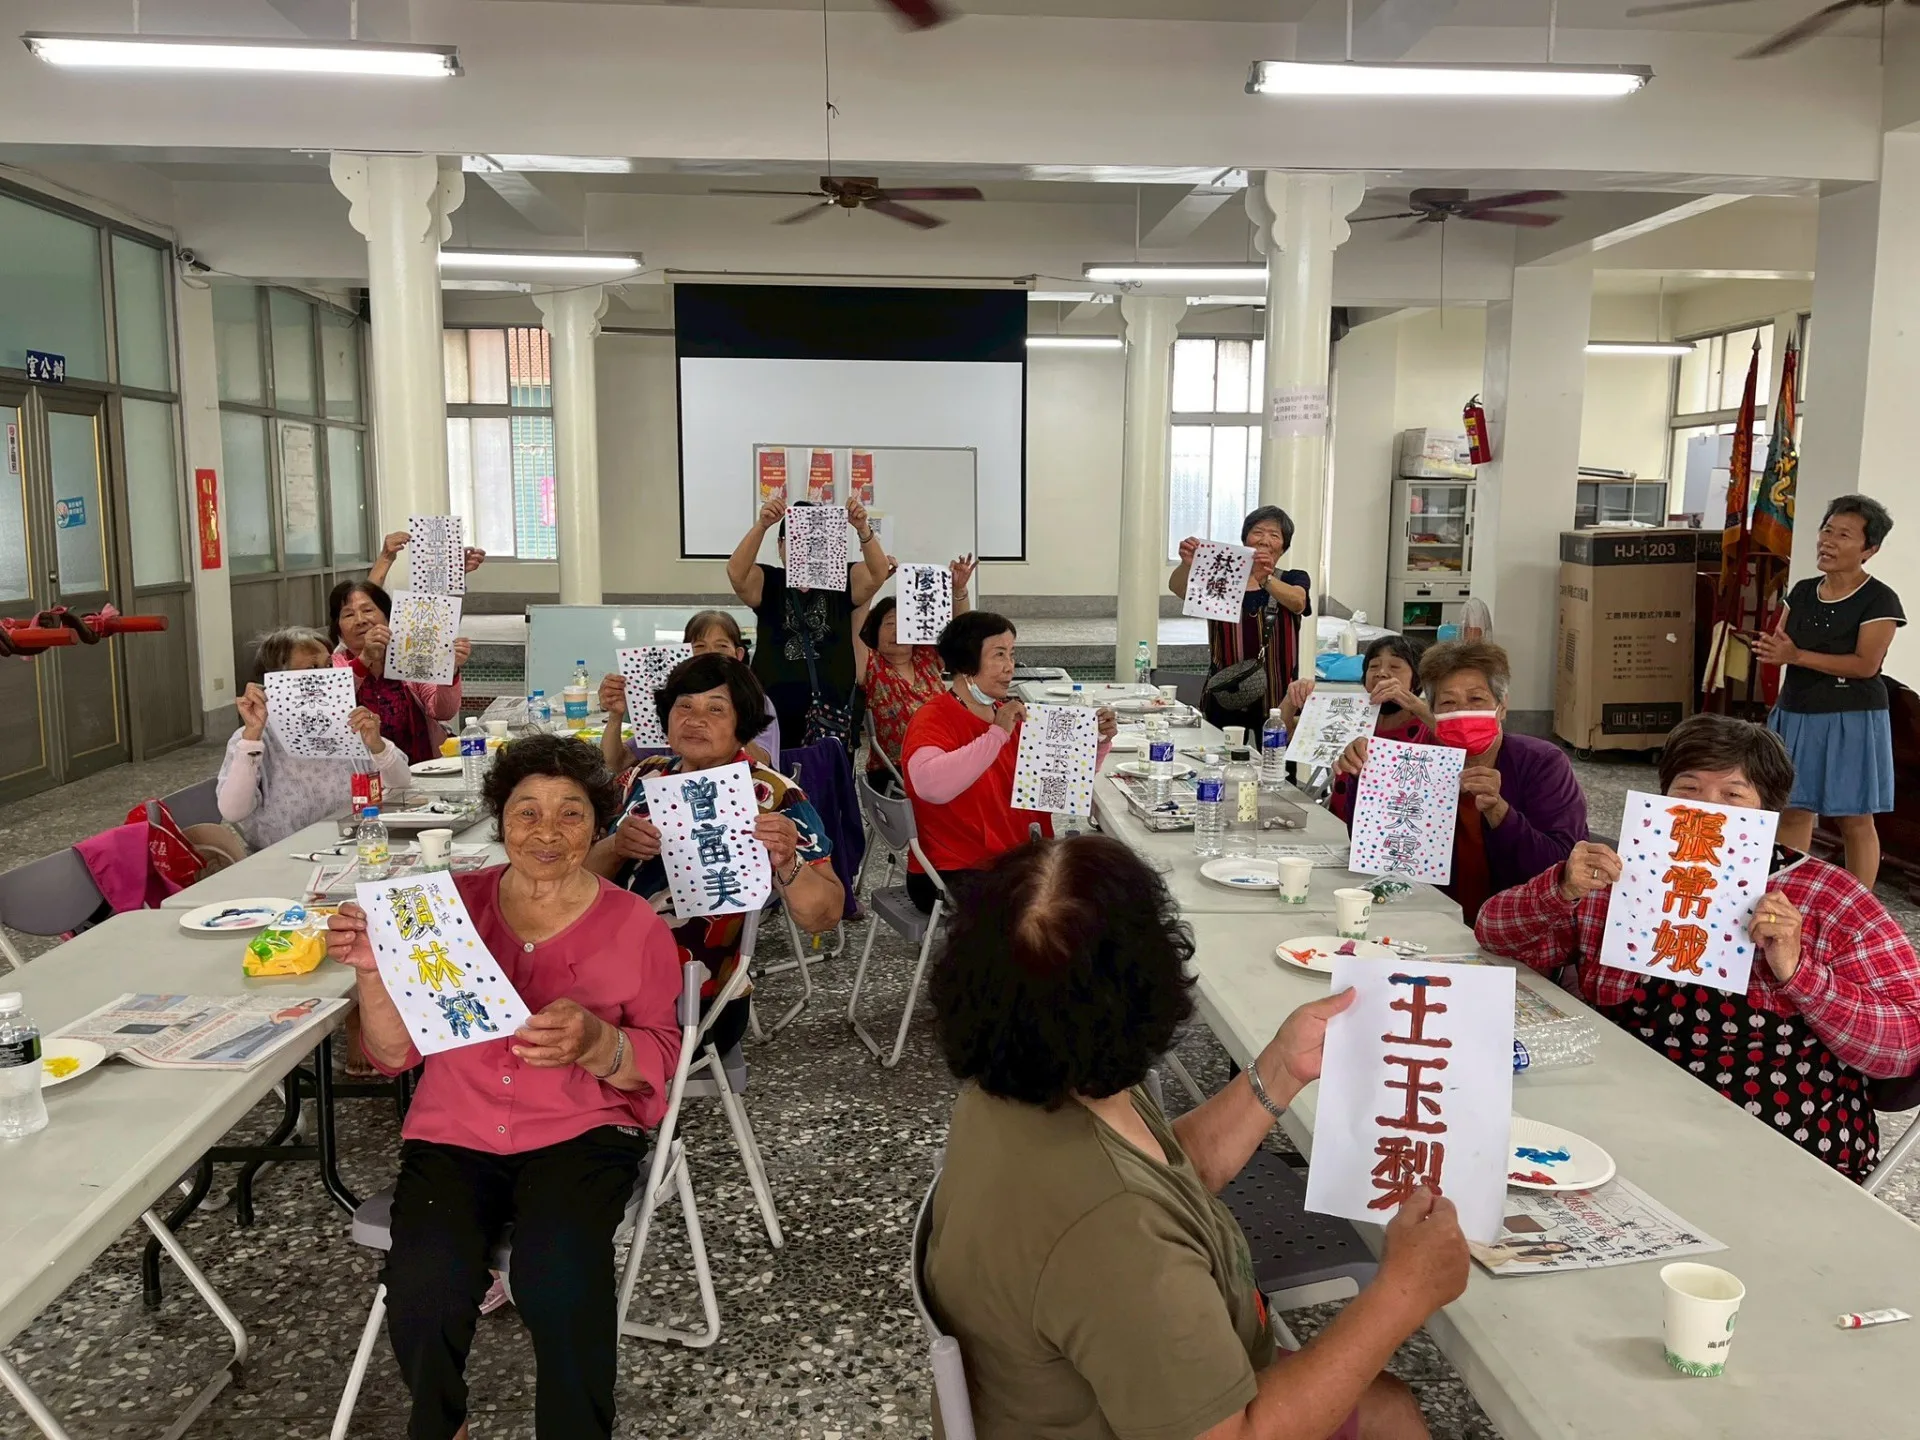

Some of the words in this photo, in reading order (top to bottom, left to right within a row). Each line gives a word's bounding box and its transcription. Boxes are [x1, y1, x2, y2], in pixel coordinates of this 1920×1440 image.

[1614, 543, 1676, 558] HJ-1203
[681, 776, 747, 911] 曾富美
[1381, 748, 1433, 876] 林美雲
[1646, 804, 1728, 977] 張常娥
[1366, 972, 1452, 1211] 王玉梨
